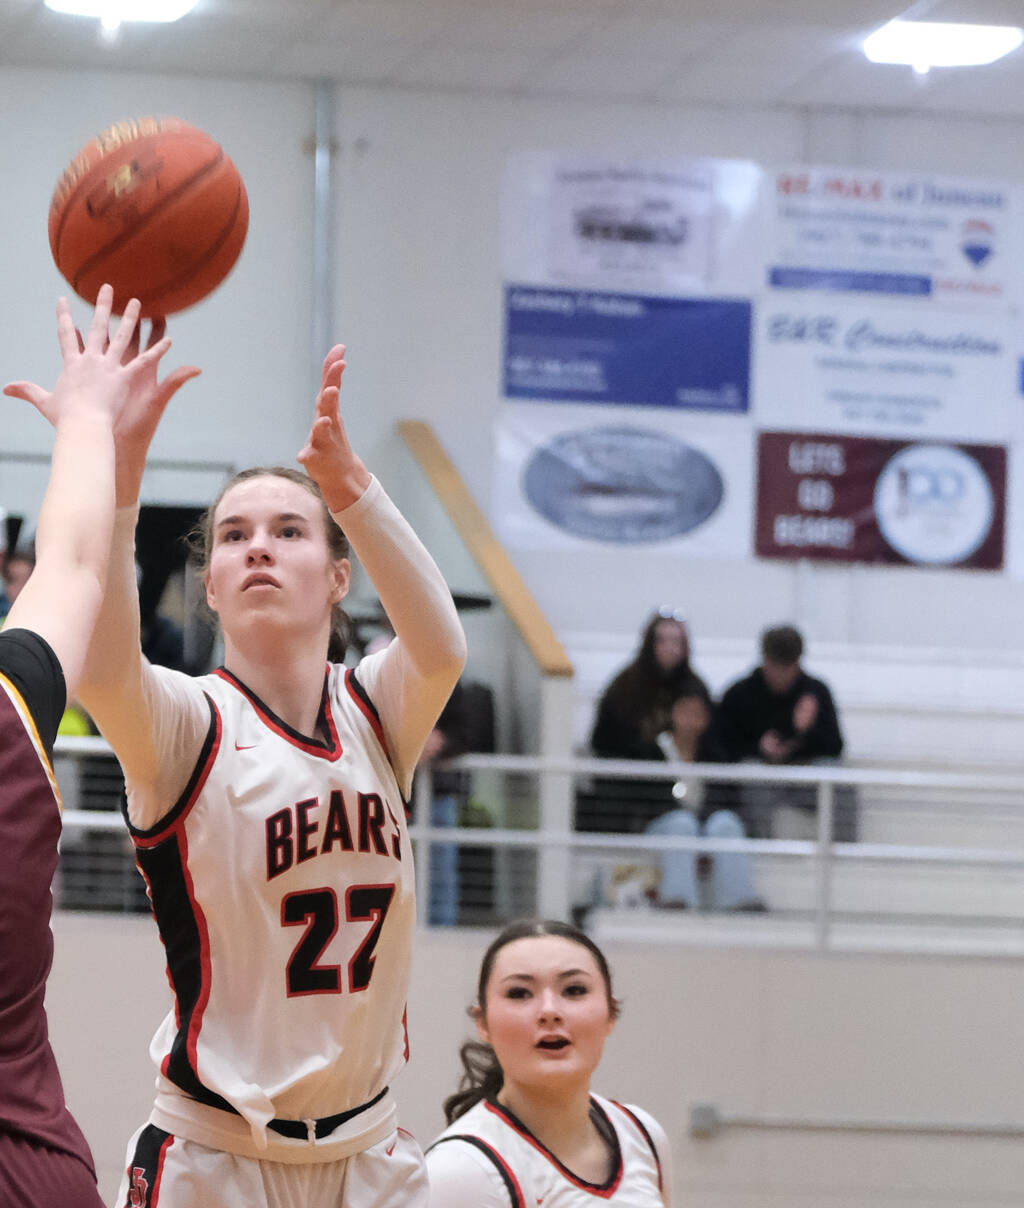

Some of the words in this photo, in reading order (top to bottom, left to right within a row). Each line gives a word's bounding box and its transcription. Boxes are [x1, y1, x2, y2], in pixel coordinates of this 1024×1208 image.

[788, 441, 846, 477] LETS
[797, 478, 835, 512] GO
[280, 882, 396, 999] 22
